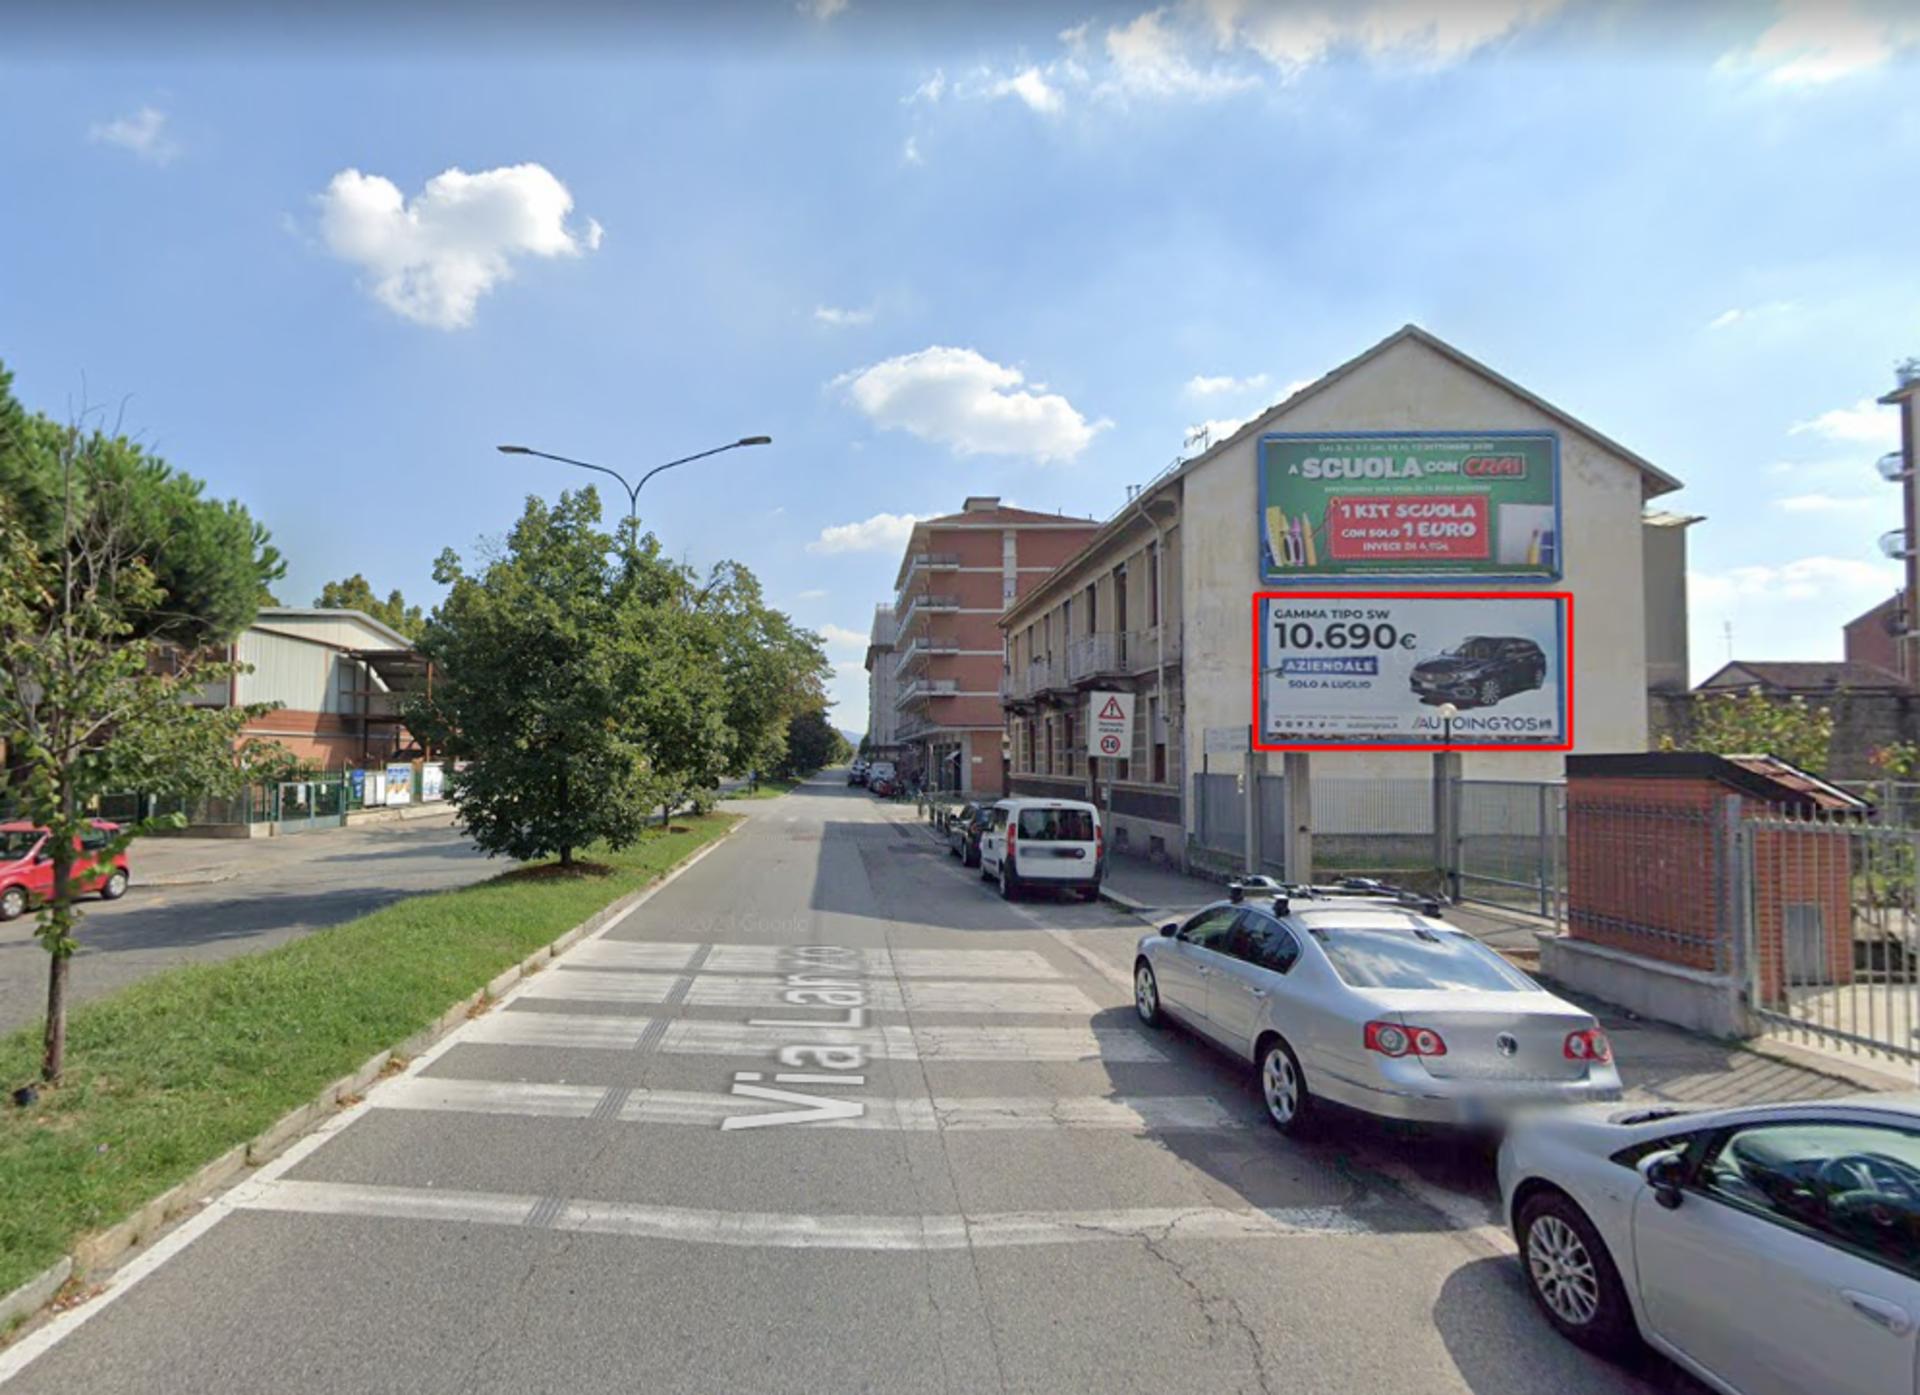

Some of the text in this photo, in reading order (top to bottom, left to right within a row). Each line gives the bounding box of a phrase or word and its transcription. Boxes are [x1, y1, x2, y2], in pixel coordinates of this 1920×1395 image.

[1288, 464, 1298, 475] A
[1302, 457, 1423, 479] SCUOLA
[1425, 461, 1459, 473] CON
[1340, 504, 1477, 518] 1 KIT SCUOLA
[1341, 521, 1477, 538] CON SOLO 1 EURO
[1363, 541, 1401, 551] INVECE
[1274, 609, 1390, 620] GAMMA TIPO SW
[1285, 660, 1375, 674] AZIENDALE
[1288, 680, 1372, 690] SOLO A LUGLIO
